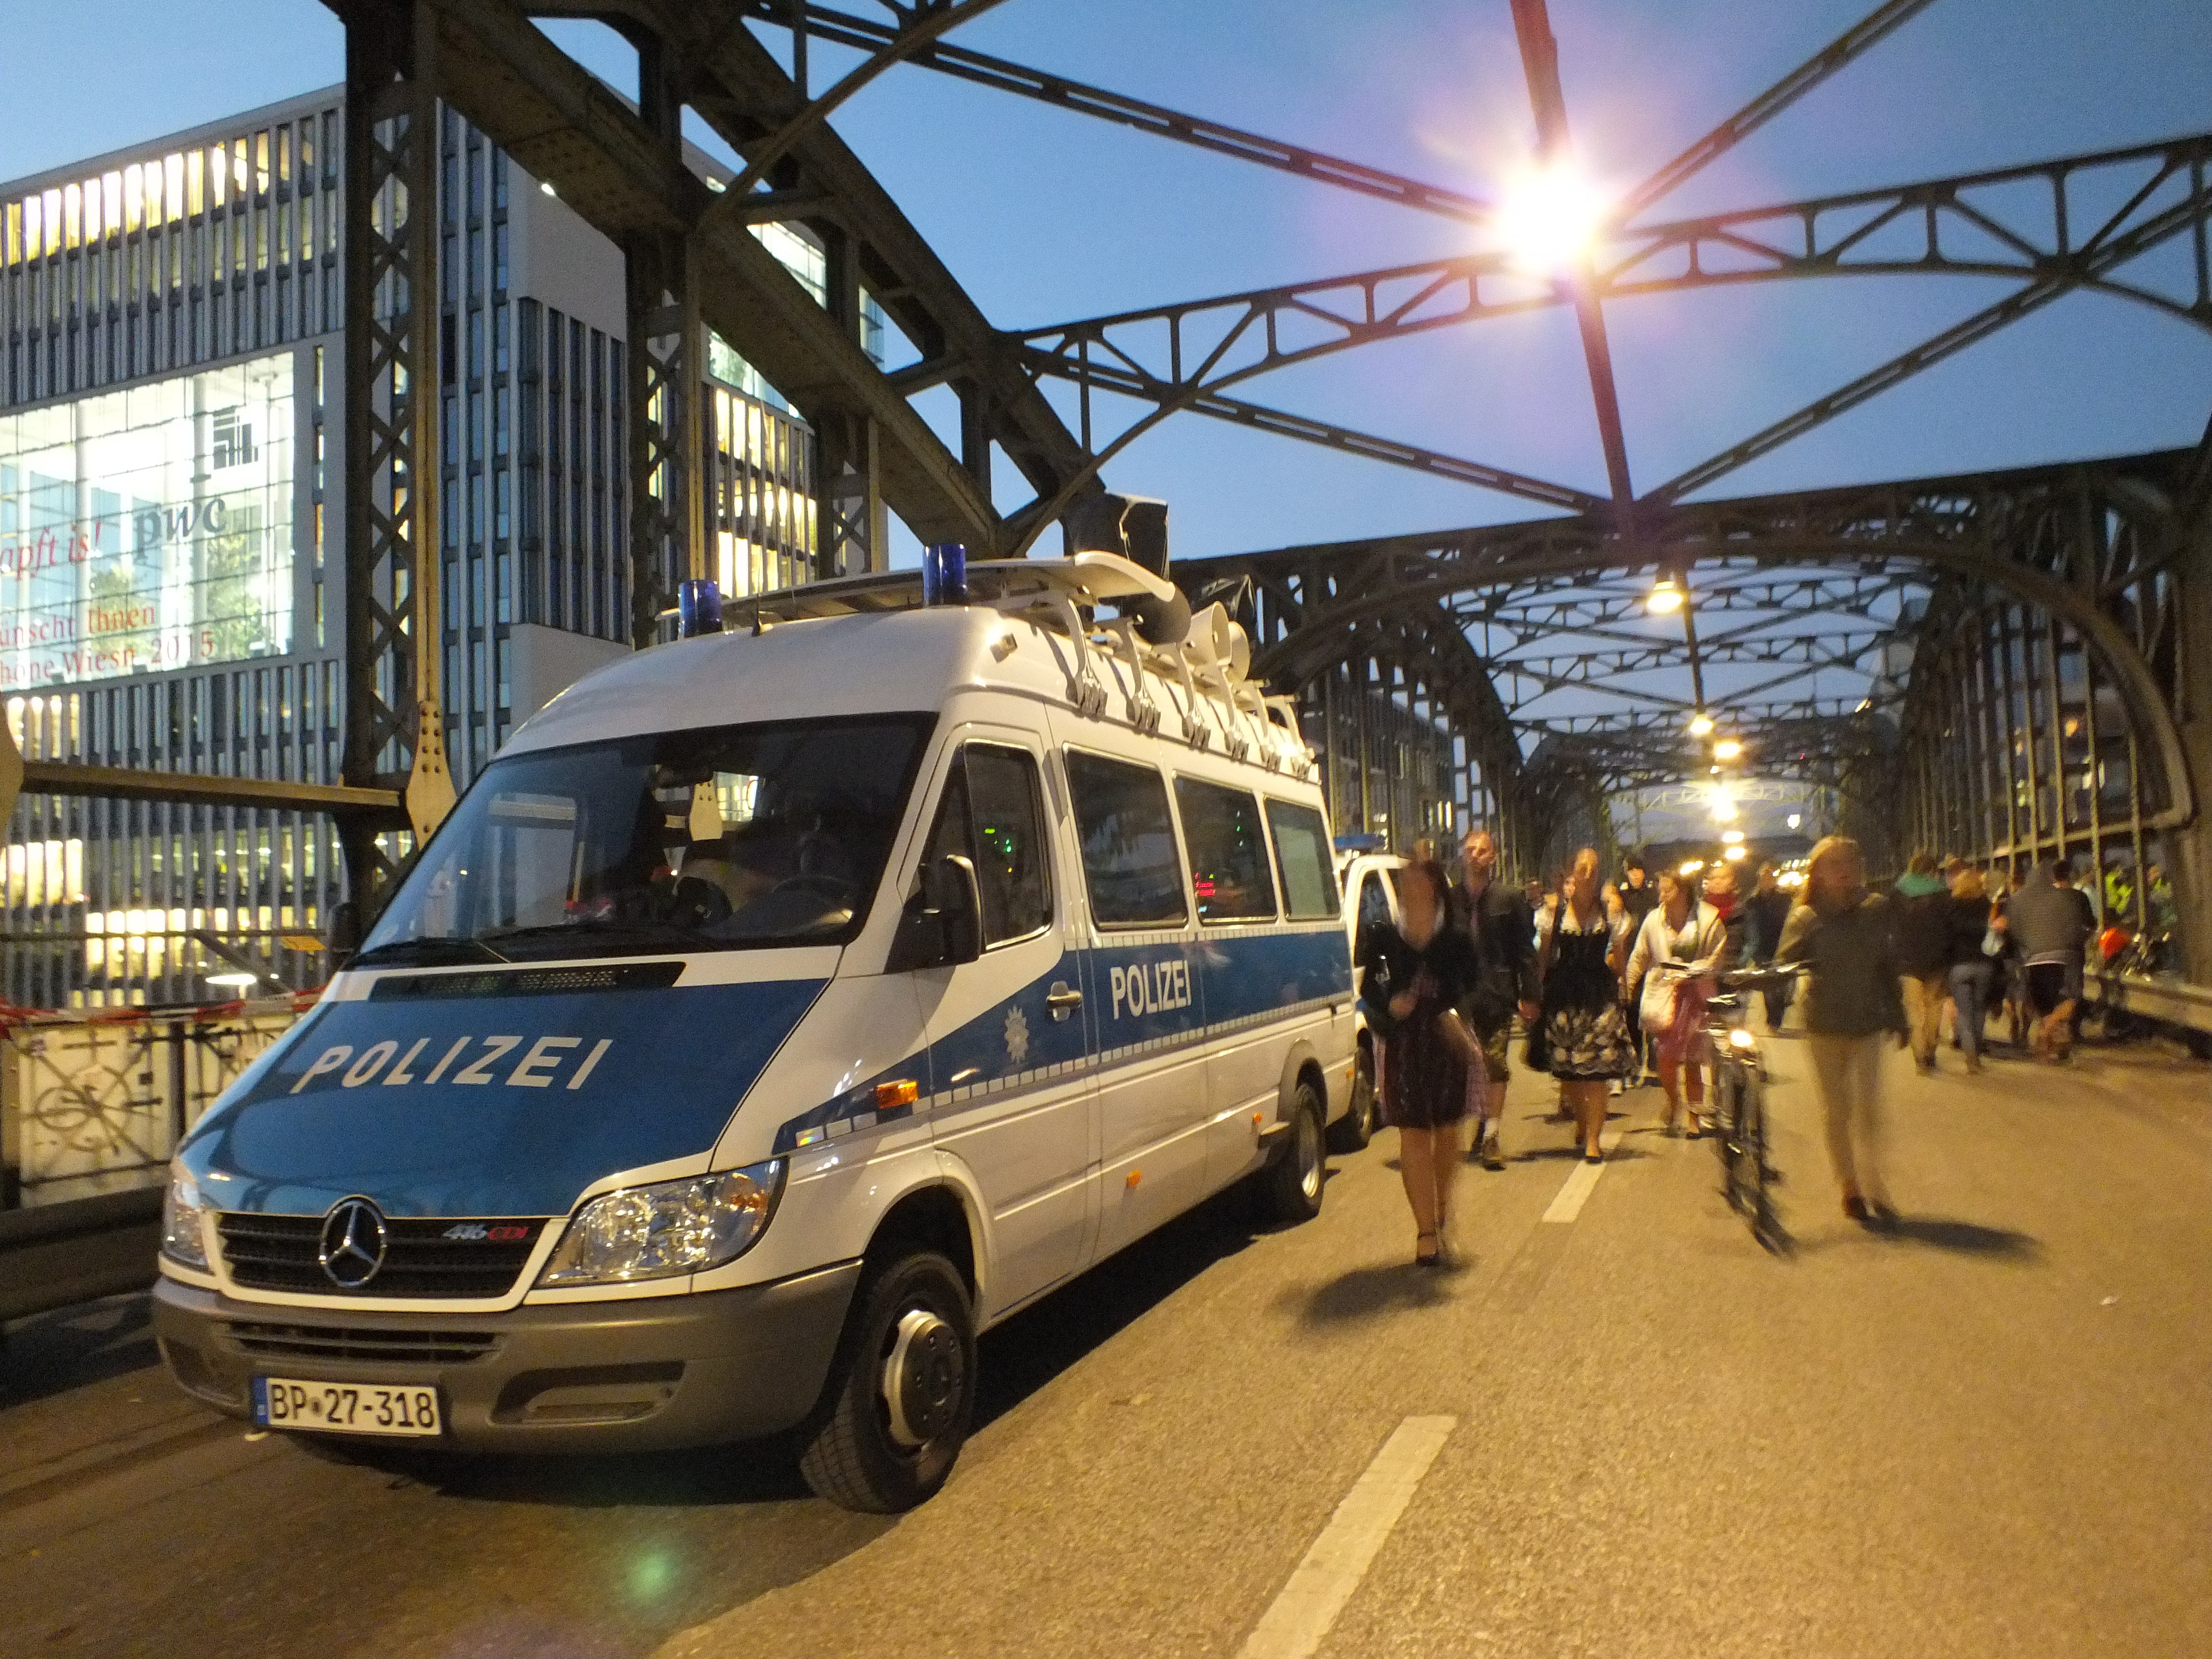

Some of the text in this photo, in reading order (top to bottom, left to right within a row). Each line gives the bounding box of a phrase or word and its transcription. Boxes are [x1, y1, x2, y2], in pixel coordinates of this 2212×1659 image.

[133, 498, 225, 560] pwc
[88, 606, 155, 634] Ihnen
[63, 650, 135, 674] Wiesn
[151, 630, 213, 663] 2015
[1109, 960, 1192, 1020] POLIZEI
[290, 1035, 613, 1094] POLIZEI
[487, 1226, 530, 1240] CDI
